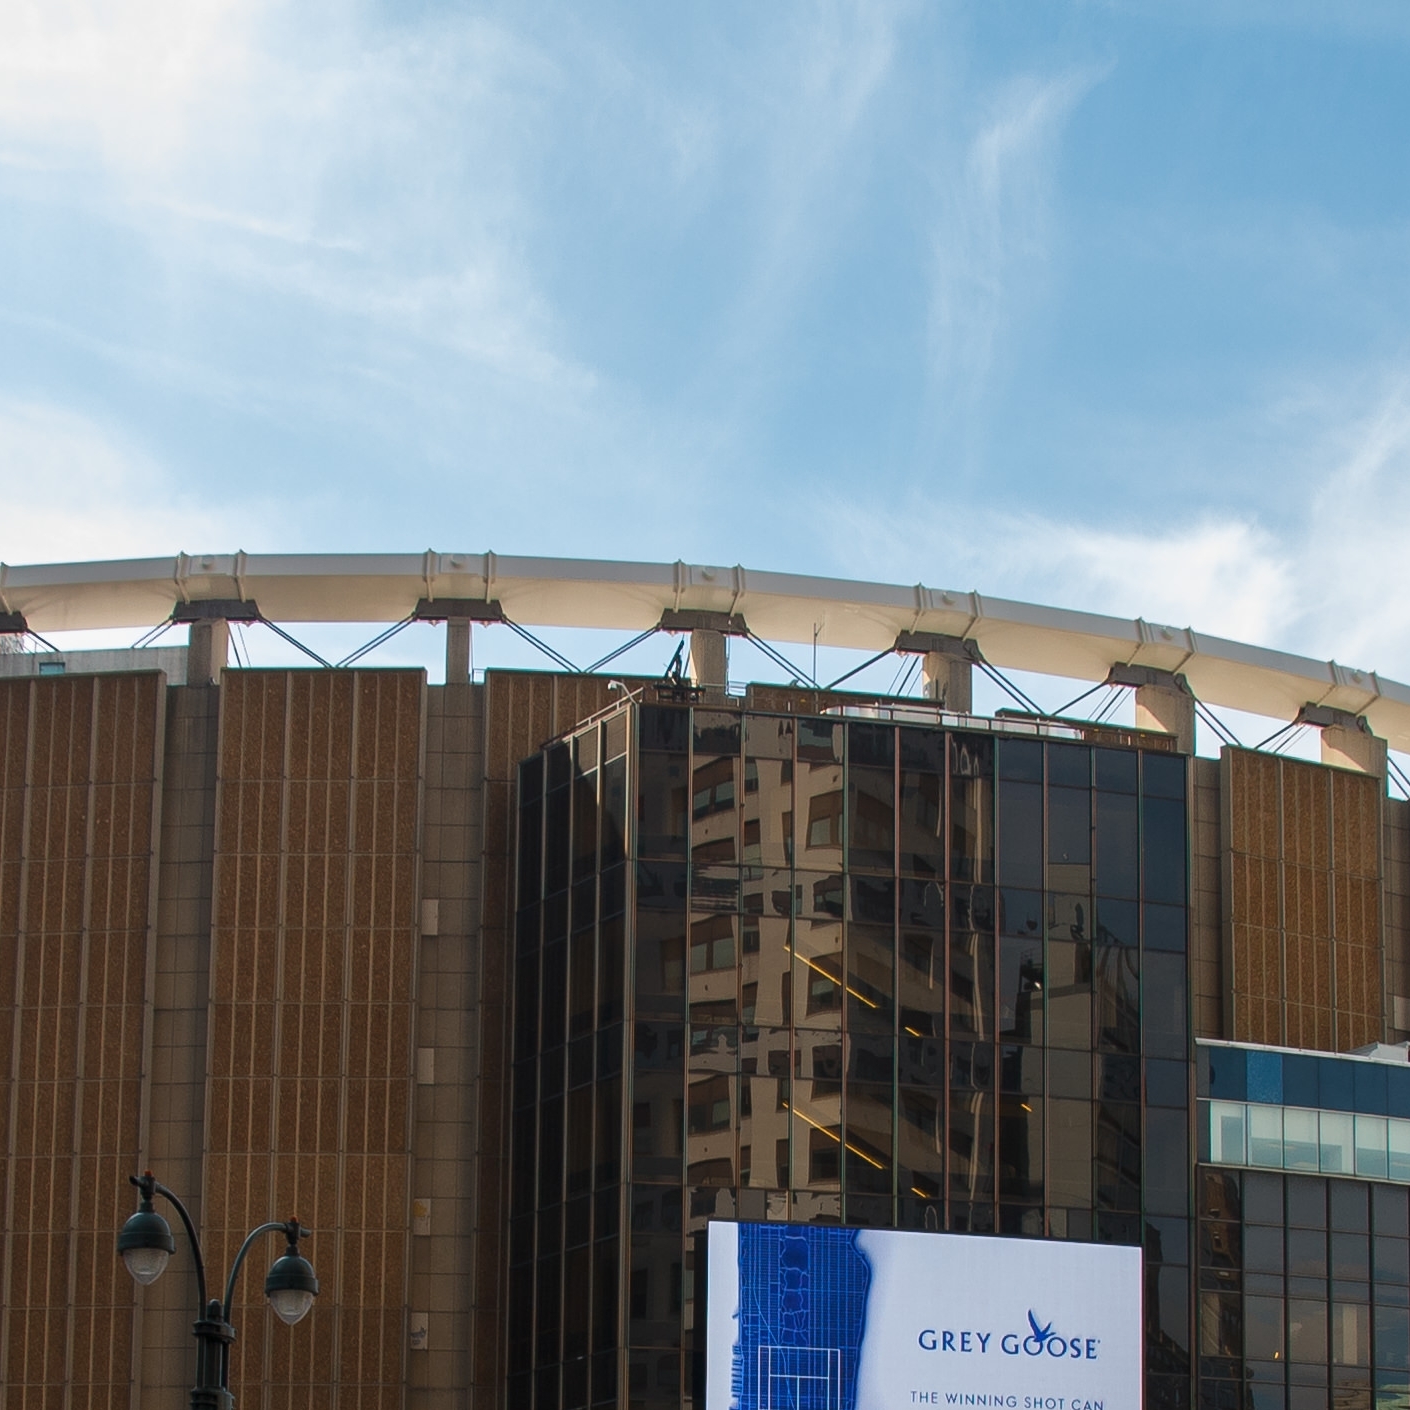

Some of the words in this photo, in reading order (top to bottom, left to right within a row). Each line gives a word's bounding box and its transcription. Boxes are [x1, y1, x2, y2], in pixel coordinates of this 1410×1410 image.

[918, 1328, 990, 1354] GREY
[1000, 1331, 1099, 1360] GOOSE
[910, 1390, 938, 1405] THE
[945, 1391, 1018, 1409] WINNING
[1023, 1395, 1065, 1410] SHOT
